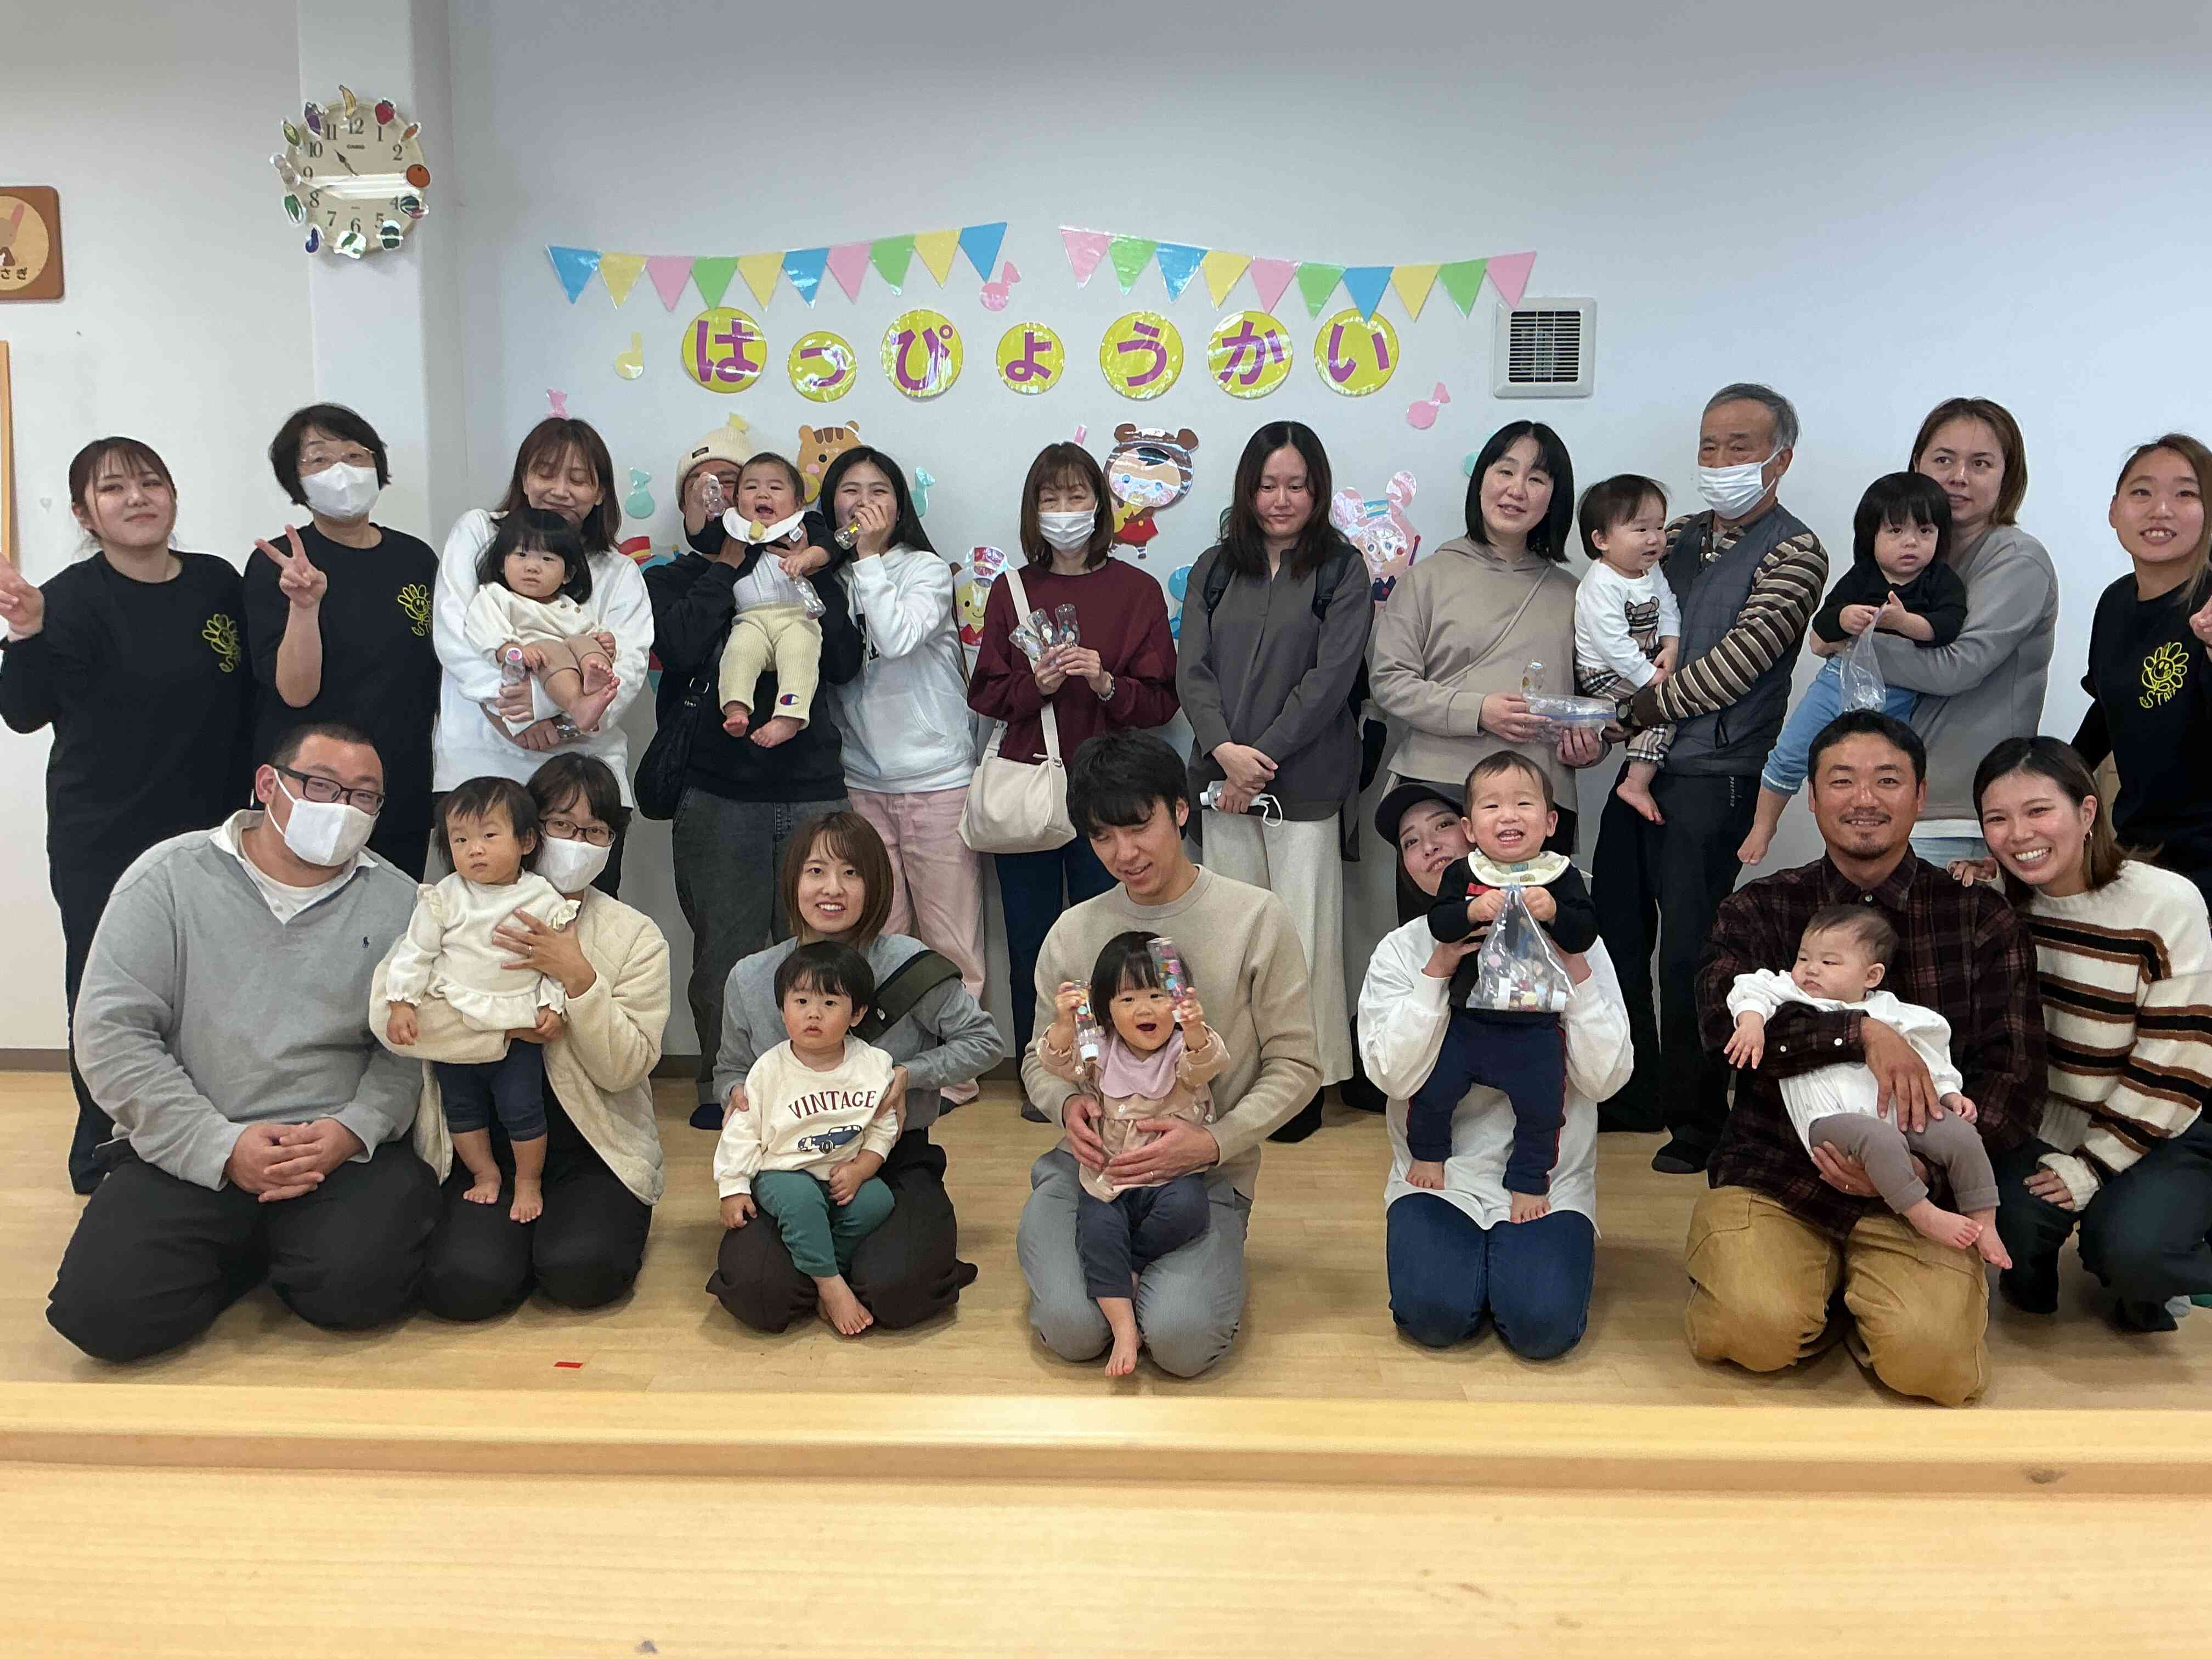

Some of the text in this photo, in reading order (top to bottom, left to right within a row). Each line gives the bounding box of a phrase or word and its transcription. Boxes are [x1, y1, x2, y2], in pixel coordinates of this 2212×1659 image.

[326, 124, 337, 140] 11
[348, 117, 364, 134] 12
[309, 140, 323, 157] 10
[392, 144, 403, 161] 2
[303, 166, 314, 180] 9
[309, 190, 319, 208] 8
[327, 210, 336, 227] 7
[351, 217, 360, 233] 6
[696, 318, 1390, 390] はっぴょうかい
[2140, 687, 2177, 708] STAFF
[788, 1091, 877, 1119] VINTAGE
